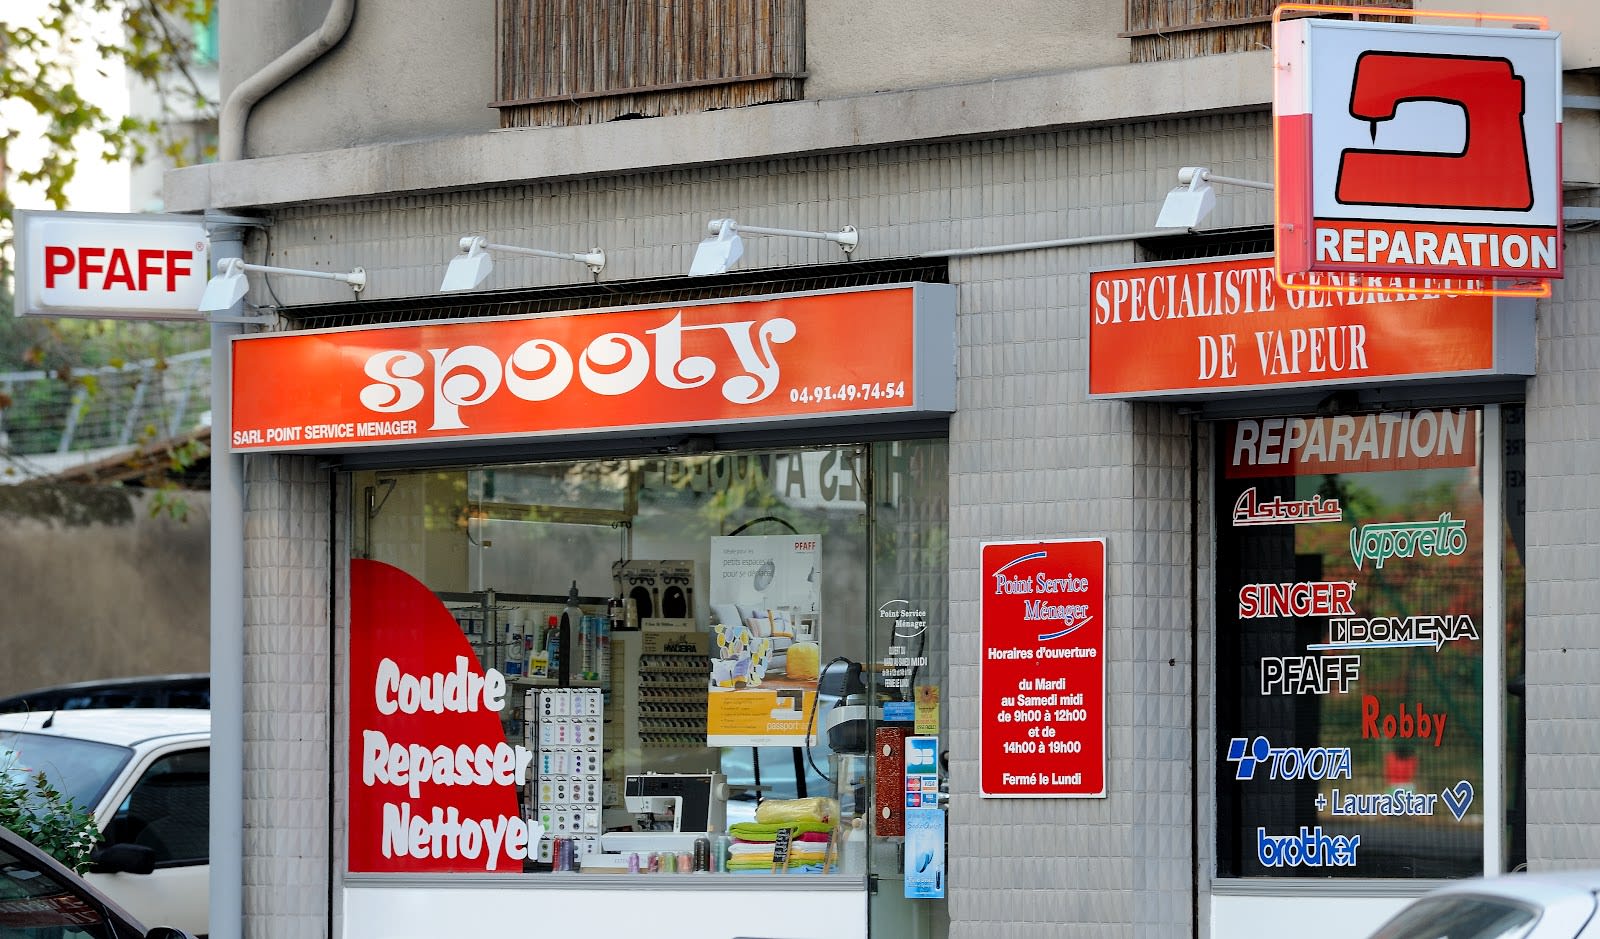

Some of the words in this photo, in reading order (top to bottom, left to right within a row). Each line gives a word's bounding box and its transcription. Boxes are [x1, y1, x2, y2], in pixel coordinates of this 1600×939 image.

[1315, 228, 1557, 269] REPARATION
[45, 246, 193, 292] PFAFF
[1095, 267, 1275, 325] SPECIALISTE
[1198, 333, 1237, 380] DE
[1254, 324, 1369, 376] VAPEUR
[359, 311, 797, 431] spooty
[790, 381, 905, 404] 04.91.49.74.54
[233, 430, 265, 445] SARL
[266, 426, 302, 442] POINT
[304, 423, 355, 440] SERVICE
[356, 420, 417, 437] MENAGER
[1232, 408, 1468, 466] REPARATION
[1233, 487, 1342, 522] Astoria
[794, 542, 816, 550] PFAFF
[1350, 512, 1467, 571] Vaporetto
[995, 574, 1033, 594] Point
[1036, 572, 1088, 593] Service
[880, 609, 899, 618] Point
[900, 609, 926, 617] Service
[1024, 600, 1088, 626] Ménager
[1239, 581, 1355, 619] SINGER
[988, 647, 1033, 660] Horaires
[1035, 646, 1097, 659] d'ouverture
[375, 655, 506, 715] Coudre
[1019, 679, 1032, 690] du
[1035, 678, 1066, 690] Mardi
[1261, 655, 1360, 695] PFAFF
[997, 710, 1011, 722] de
[1014, 710, 1041, 722] 9h00
[1044, 710, 1051, 722] à
[1054, 709, 1087, 721] 12h00
[1001, 696, 1015, 707] au
[1017, 693, 1057, 706] Samedi
[1060, 693, 1083, 706] midi
[1028, 726, 1040, 737] et
[1041, 726, 1056, 737] de
[1362, 695, 1447, 746] Robby
[362, 729, 533, 798] Repasser
[1003, 741, 1036, 753] 14h00
[1038, 742, 1045, 753] à
[1048, 741, 1081, 753] 19h00
[1002, 773, 1036, 785] Fermé
[1039, 773, 1049, 785] le
[1051, 773, 1082, 785] Lundi
[1269, 748, 1351, 780] TOYOTA
[1332, 788, 1437, 816] LauraStar
[382, 802, 545, 871] Nettoyer
[1257, 826, 1360, 867] brother
